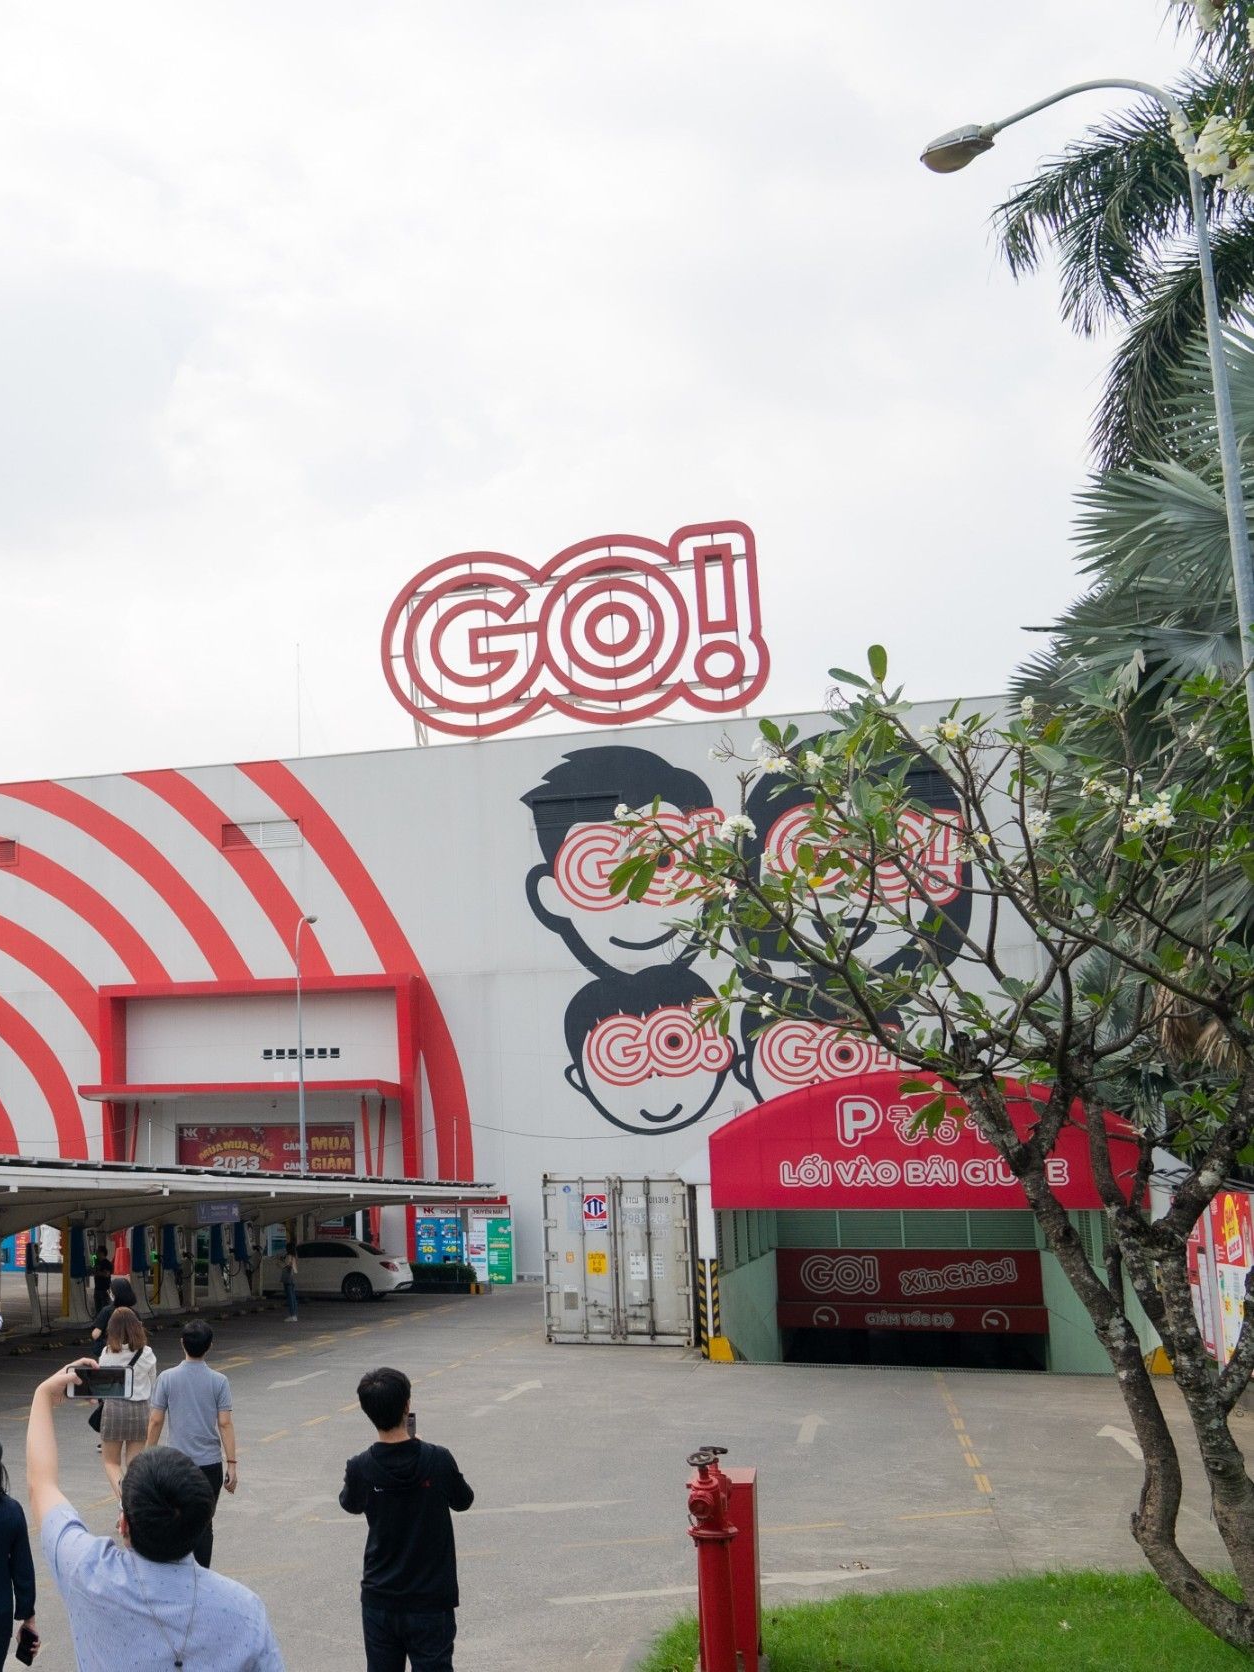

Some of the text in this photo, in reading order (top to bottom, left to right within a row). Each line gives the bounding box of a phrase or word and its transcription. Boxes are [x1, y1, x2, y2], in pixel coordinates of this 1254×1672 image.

[381, 520, 770, 737] GO!
[587, 1003, 733, 1087] GO!
[836, 1095, 883, 1148] P
[283, 1136, 351, 1150] CÀN MUA
[213, 1156, 260, 1170] 2023
[283, 1160, 309, 1170] CÀN
[780, 1154, 832, 1187] LỐI
[835, 1155, 901, 1187] VÀO
[904, 1155, 958, 1187] BÃI
[801, 1255, 1017, 1295] GO! Xin Chào!
